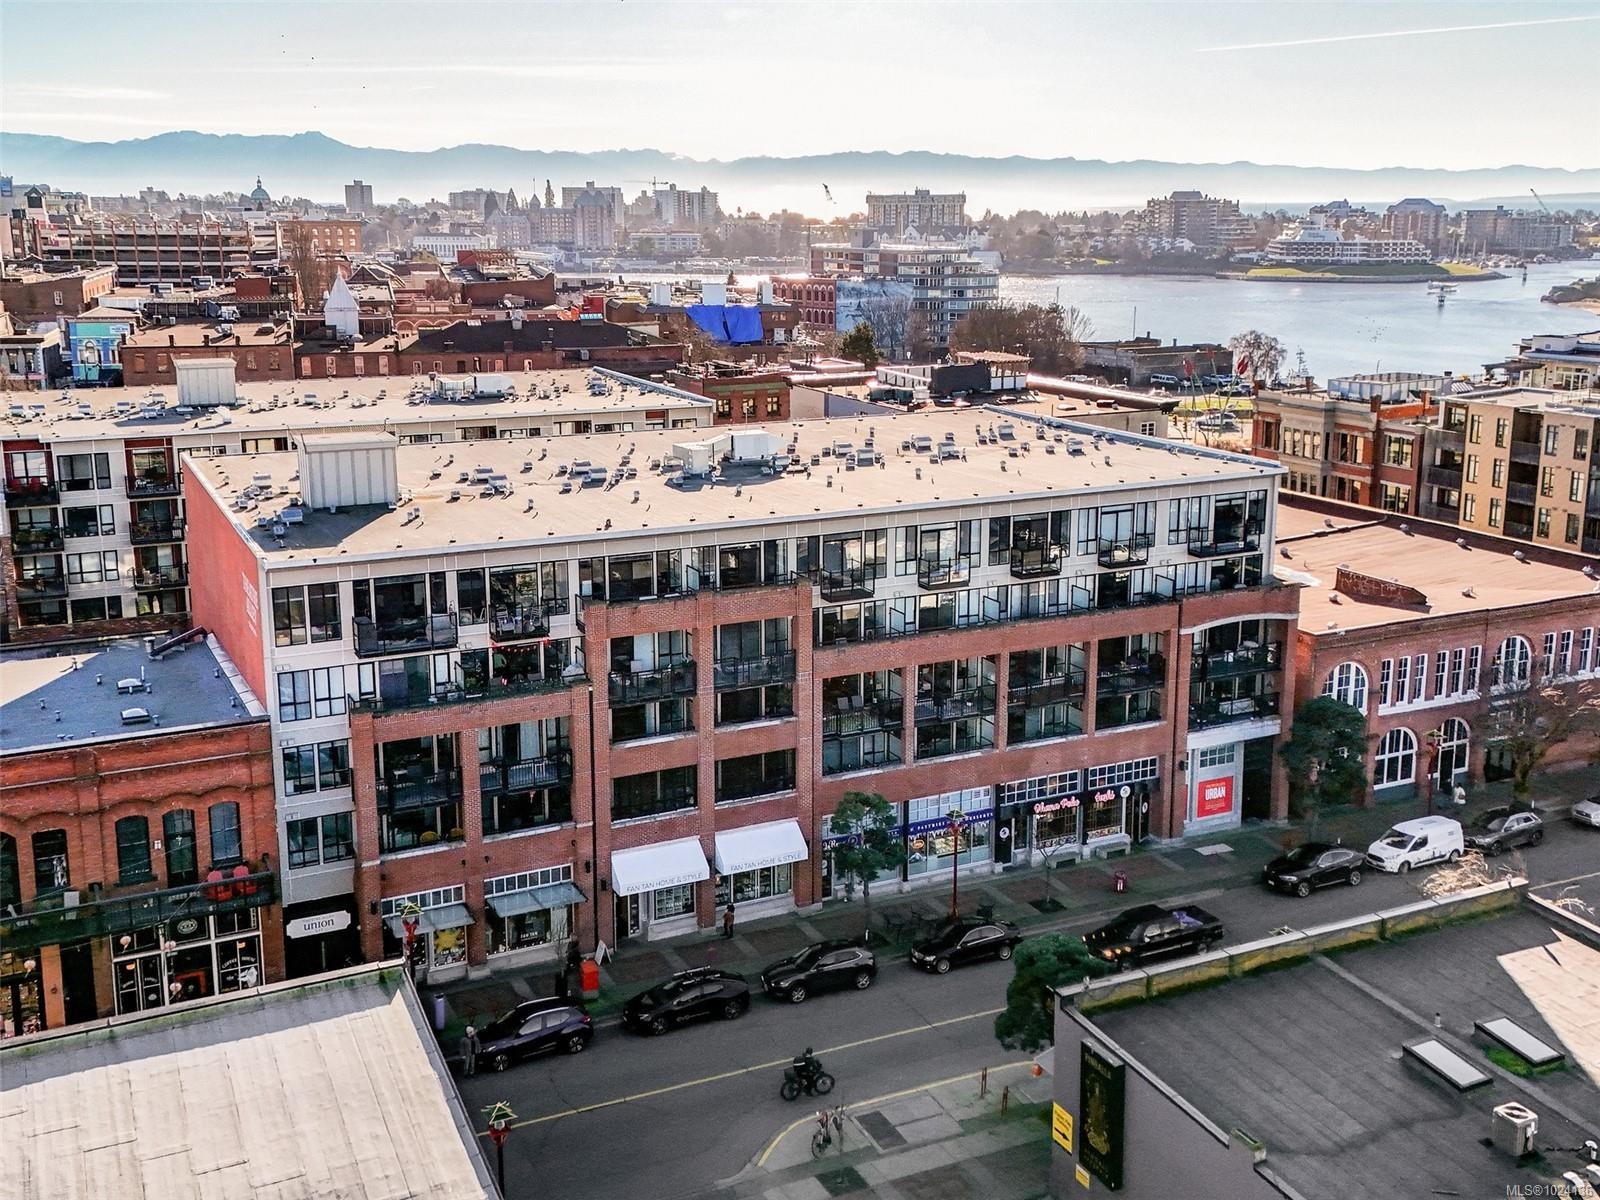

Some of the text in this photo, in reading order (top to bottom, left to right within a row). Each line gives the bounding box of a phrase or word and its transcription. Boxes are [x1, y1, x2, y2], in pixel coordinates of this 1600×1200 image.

[1205, 785, 1226, 801] URBAN
[917, 821, 945, 831] PASTRIES
[757, 857, 776, 867] HOME
[783, 852, 801, 862] STYLE
[626, 885, 640, 893] FAN
[641, 881, 655, 889] TAN
[655, 877, 675, 887] HOME
[682, 872, 703, 882] STYLE
[303, 919, 334, 931] union
